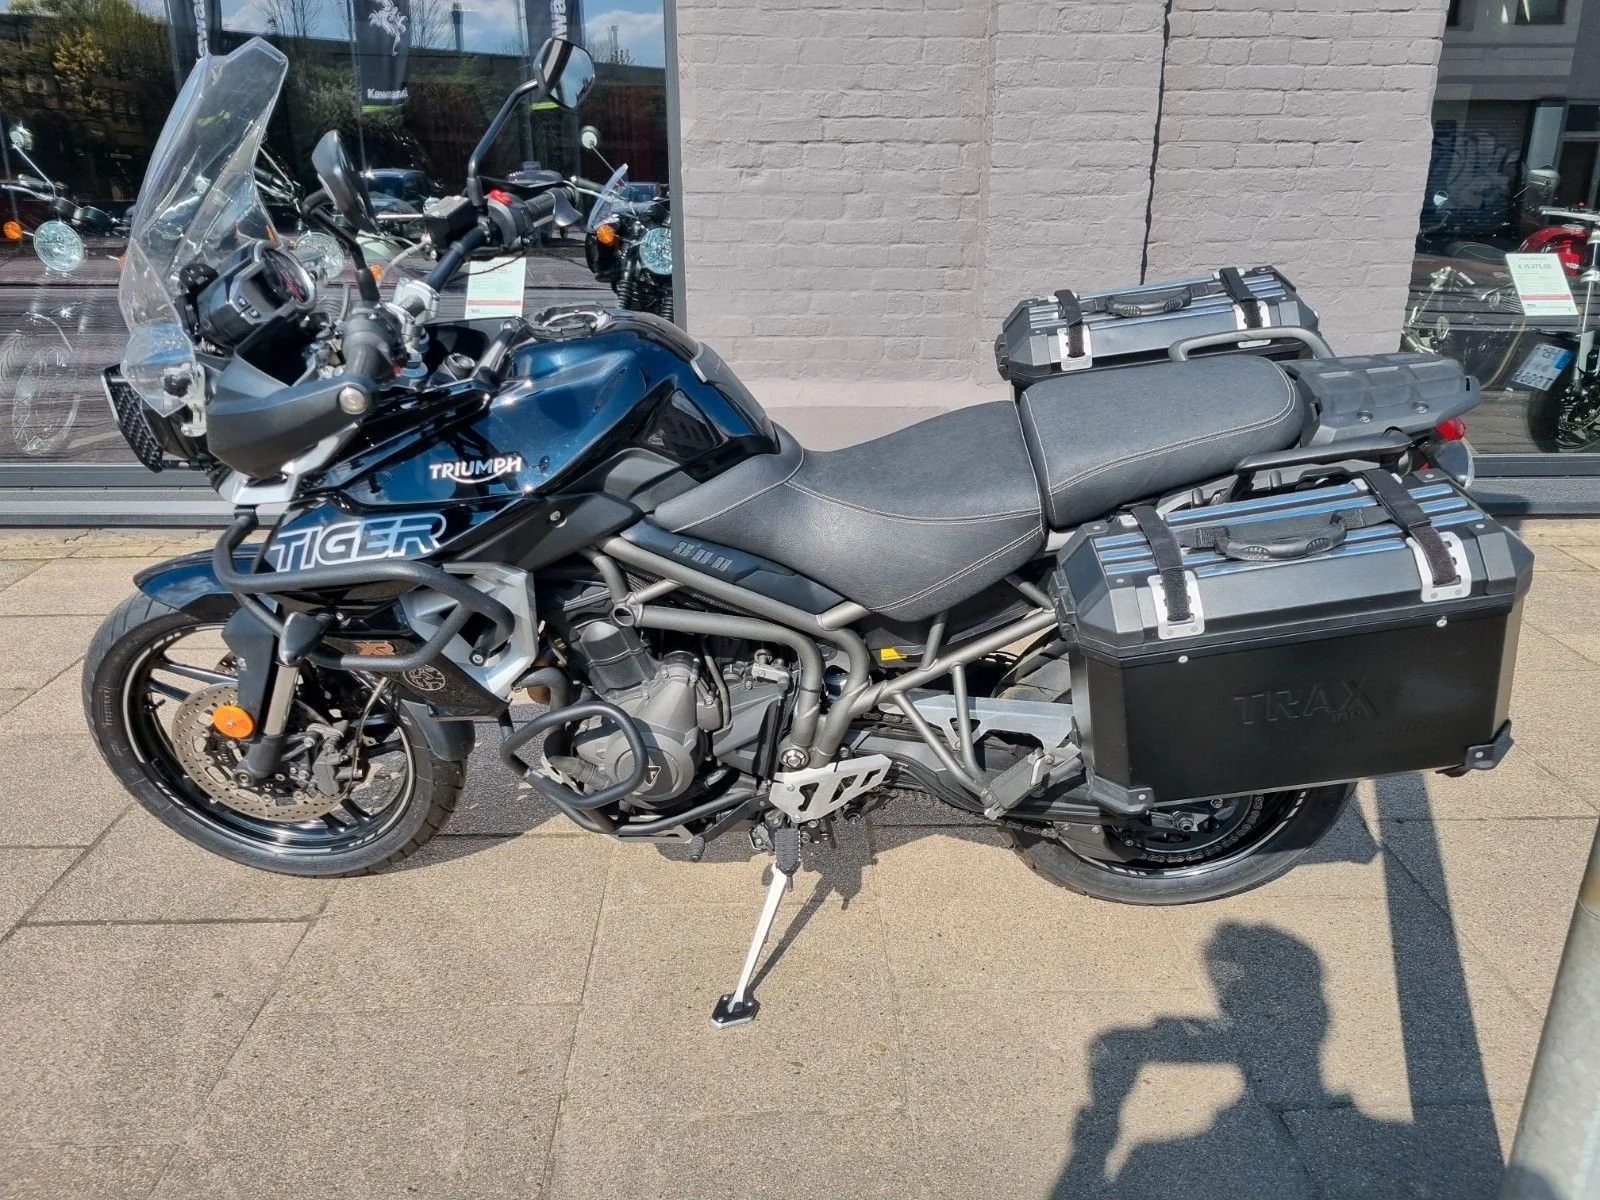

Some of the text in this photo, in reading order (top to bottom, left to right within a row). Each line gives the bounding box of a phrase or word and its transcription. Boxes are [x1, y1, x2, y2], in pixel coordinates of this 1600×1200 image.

[429, 456, 522, 484] TRIUMPH
[270, 512, 447, 573] TIGER
[1232, 678, 1380, 725] TRAX
